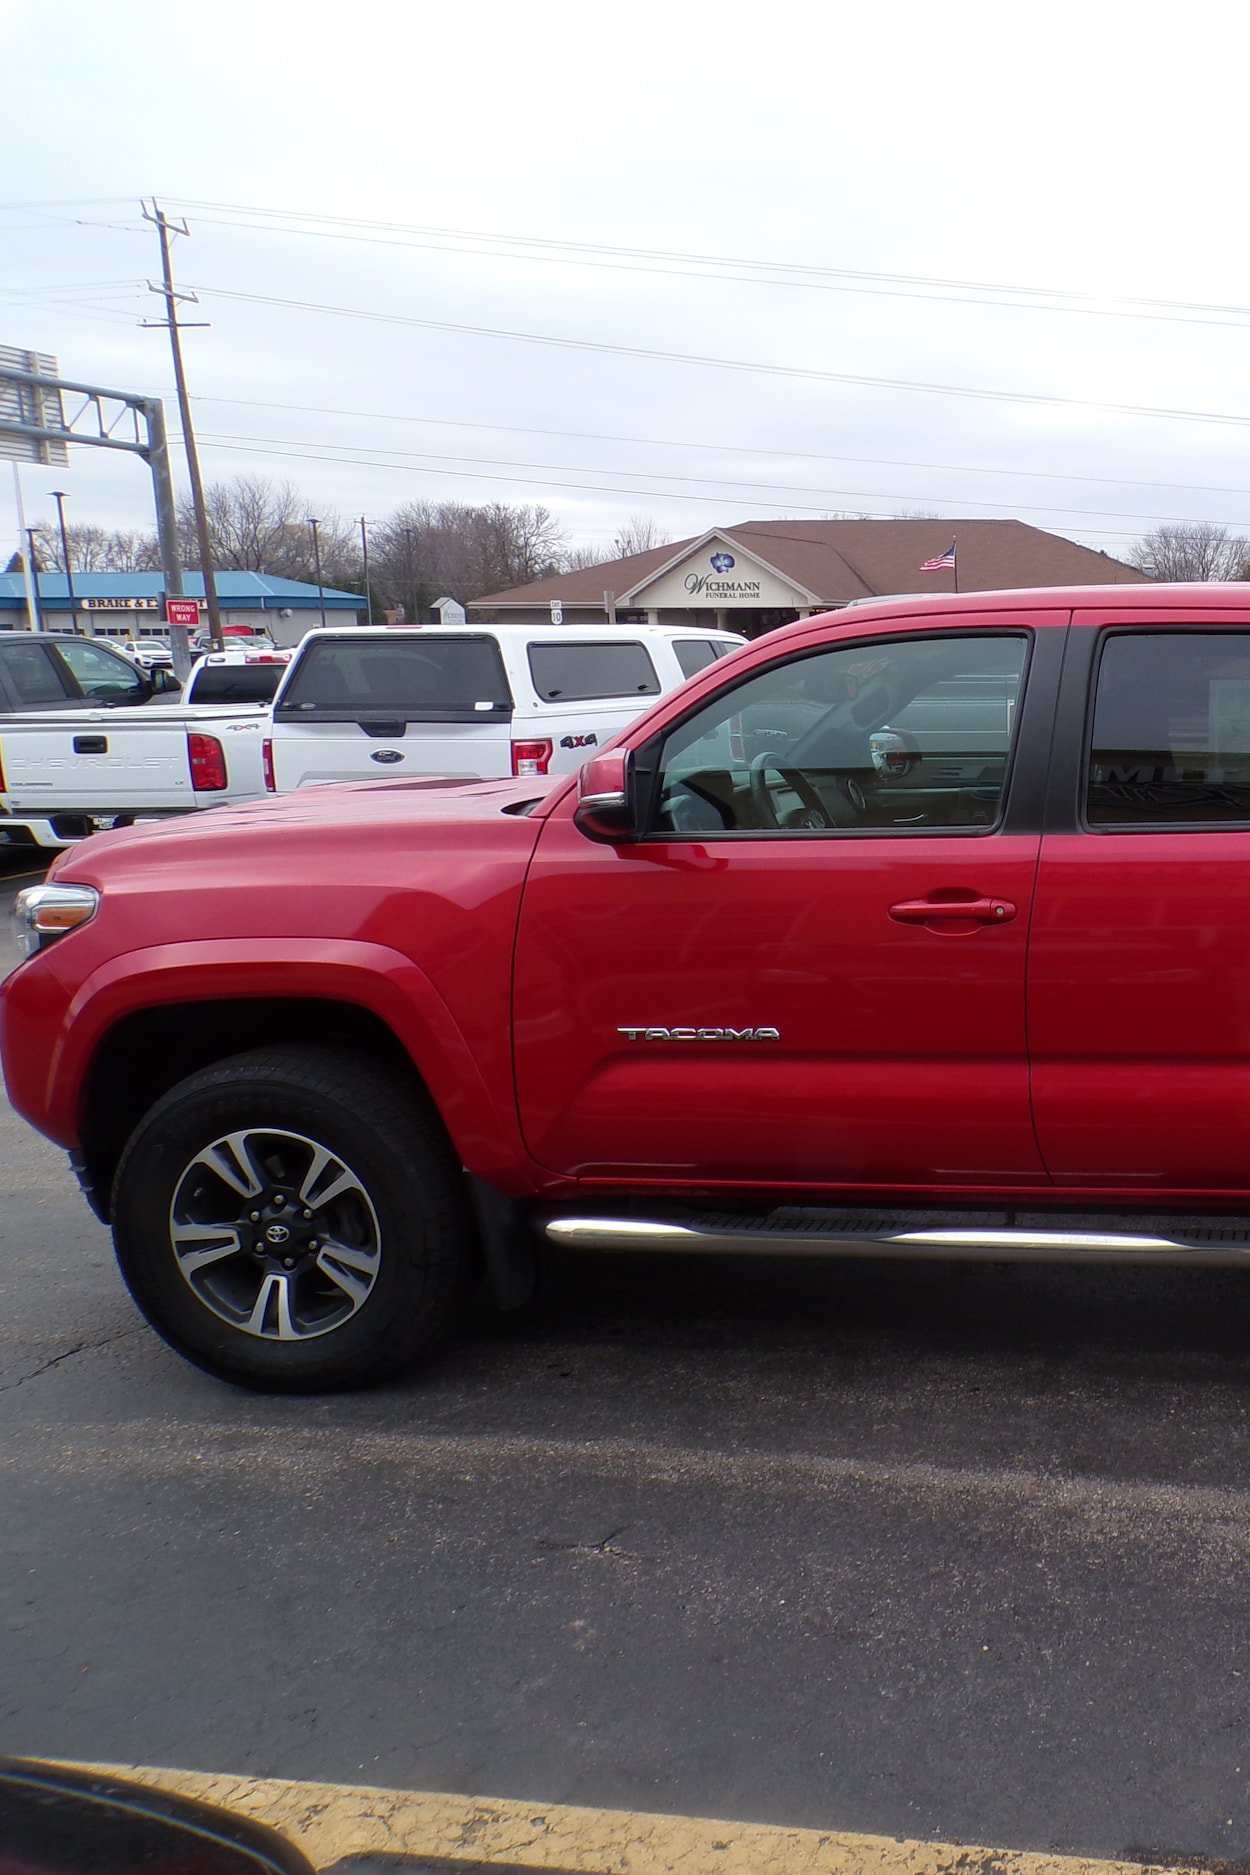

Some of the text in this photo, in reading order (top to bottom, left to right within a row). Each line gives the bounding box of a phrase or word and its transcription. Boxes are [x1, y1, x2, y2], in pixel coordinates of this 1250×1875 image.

[684, 573, 761, 595] WICHMANN
[88, 599, 132, 608] BRAKE
[134, 599, 144, 608] &
[170, 604, 196, 613] WRONG
[176, 613, 191, 621] WAY
[552, 612, 561, 622] 10
[11, 757, 179, 770] CHEVROLET
[616, 1027, 781, 1041] TACOMA
